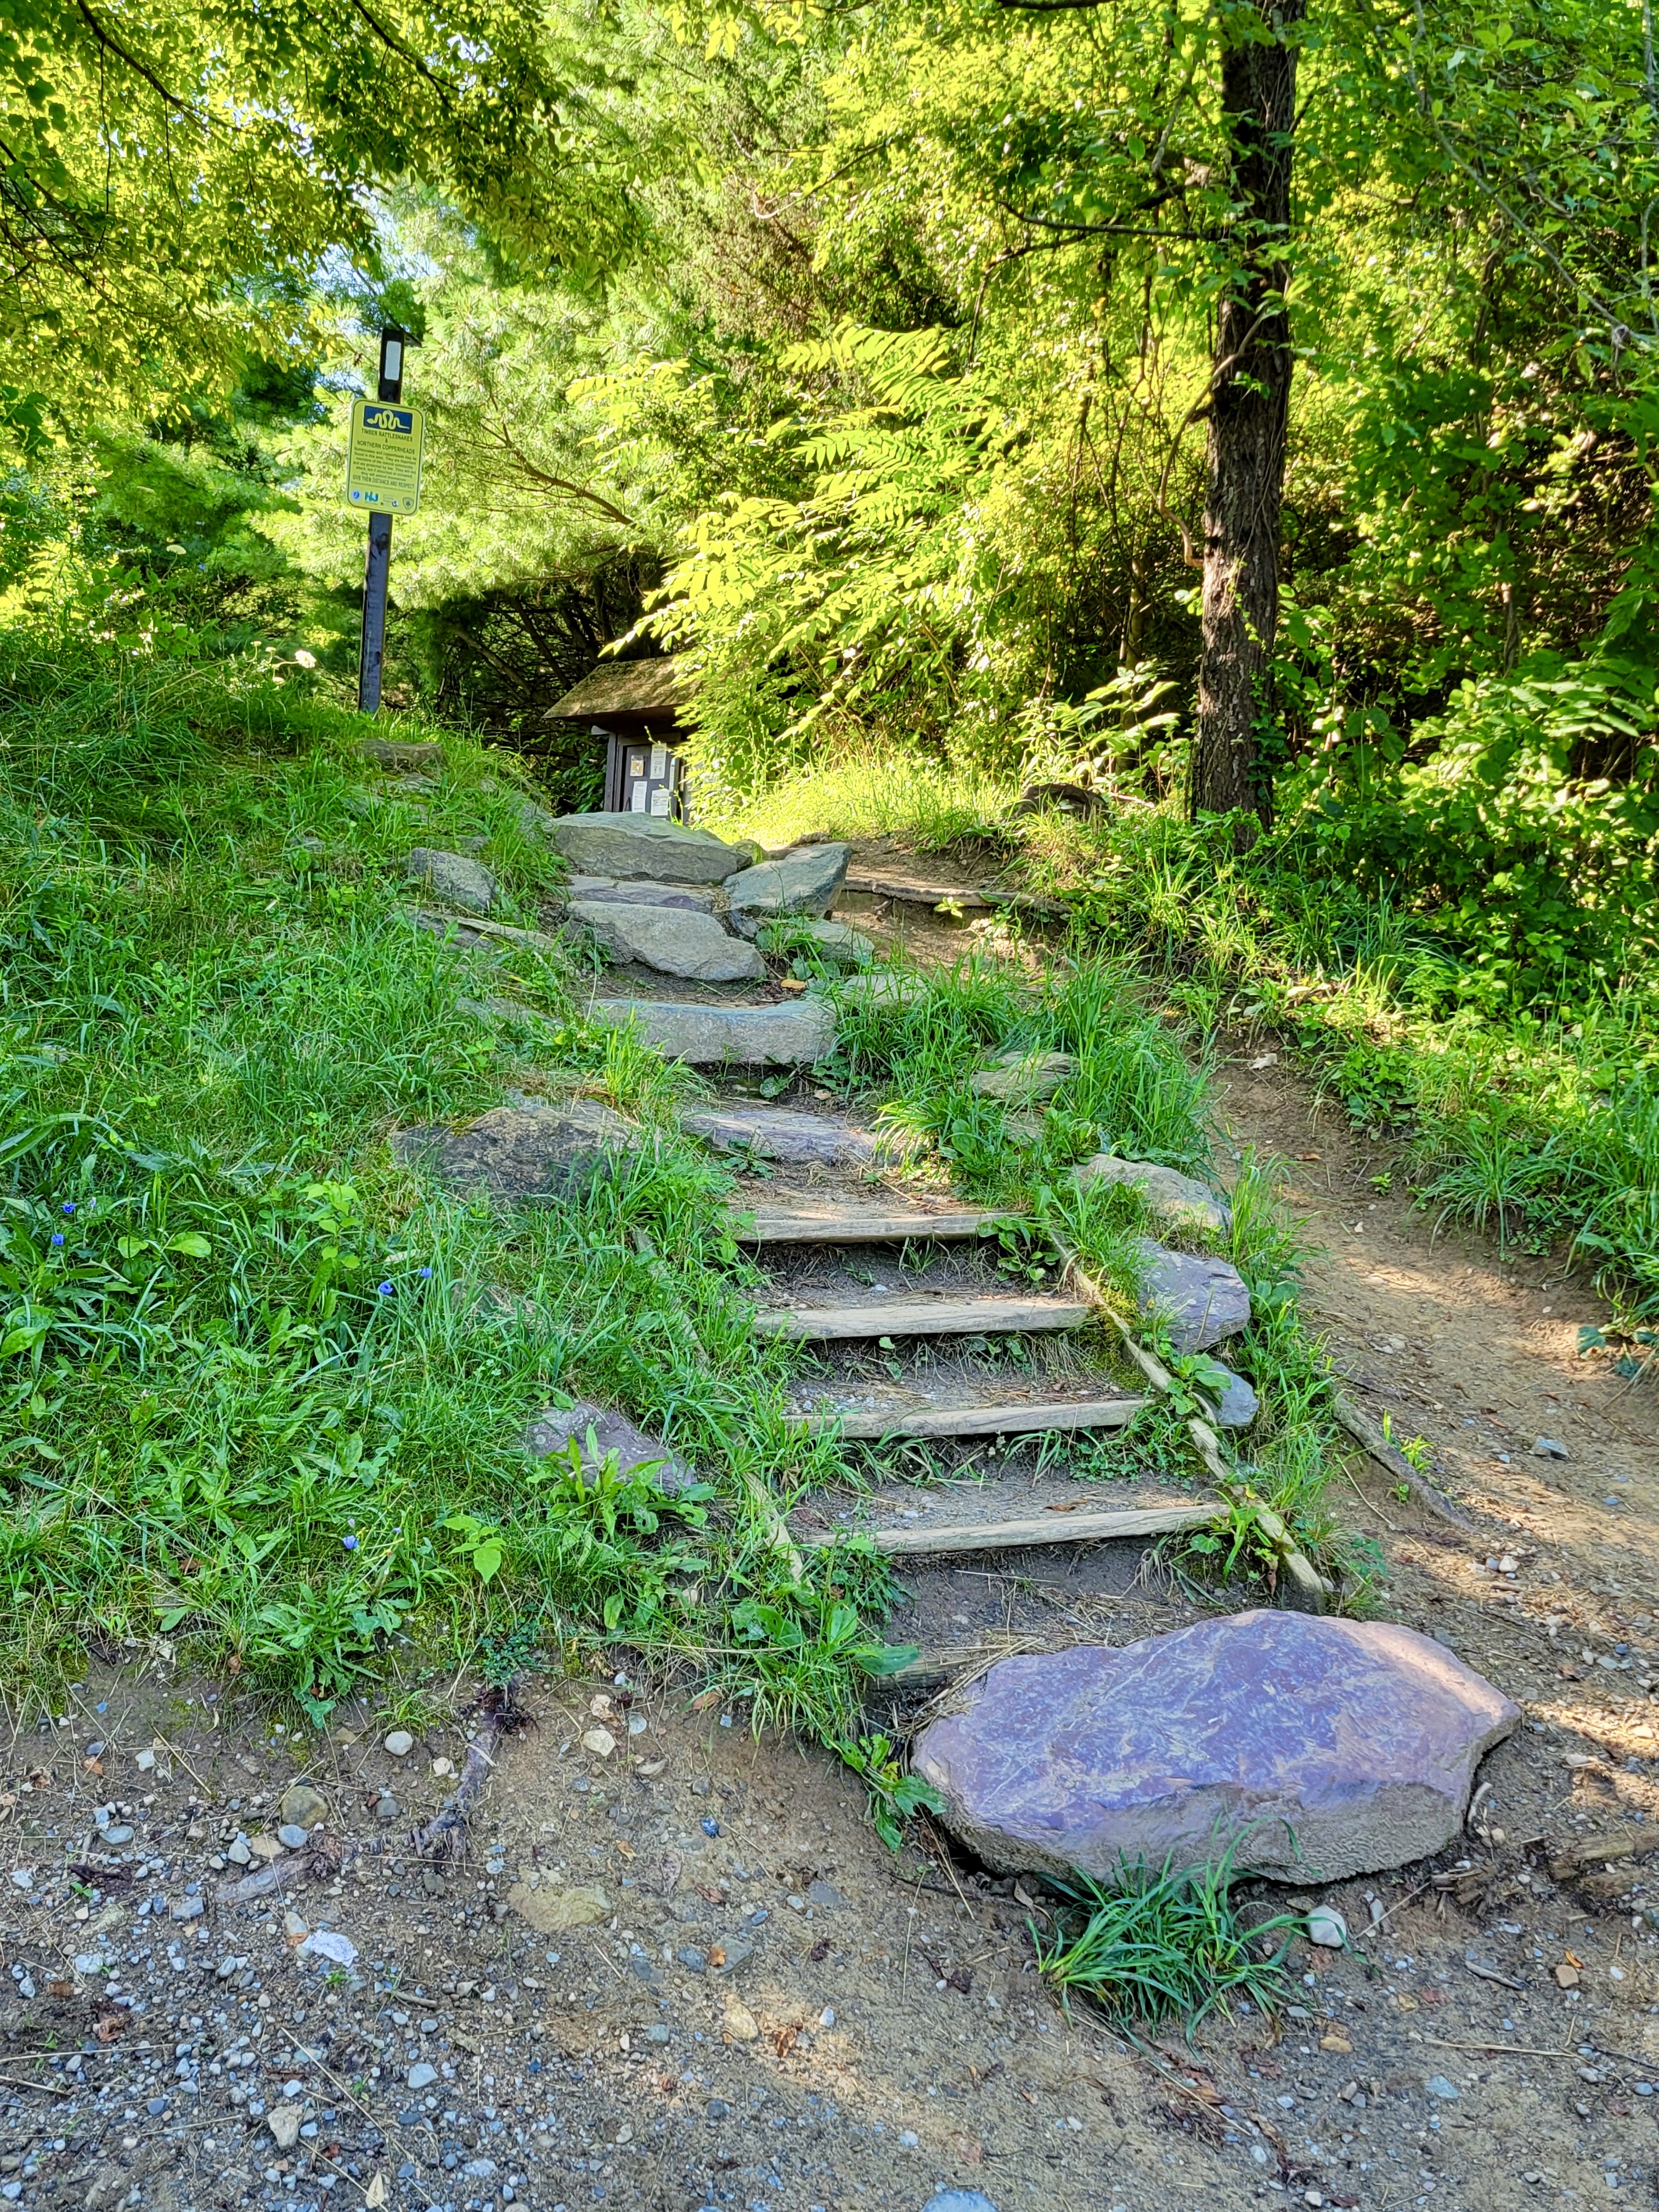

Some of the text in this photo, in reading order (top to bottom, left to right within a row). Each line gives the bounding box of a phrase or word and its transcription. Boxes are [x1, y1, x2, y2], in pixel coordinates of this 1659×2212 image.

[362, 428, 413, 442] TIMBER RATTLESNAKES
[357, 440, 381, 449] NORTHERN
[382, 444, 415, 454] COPPERHEADS
